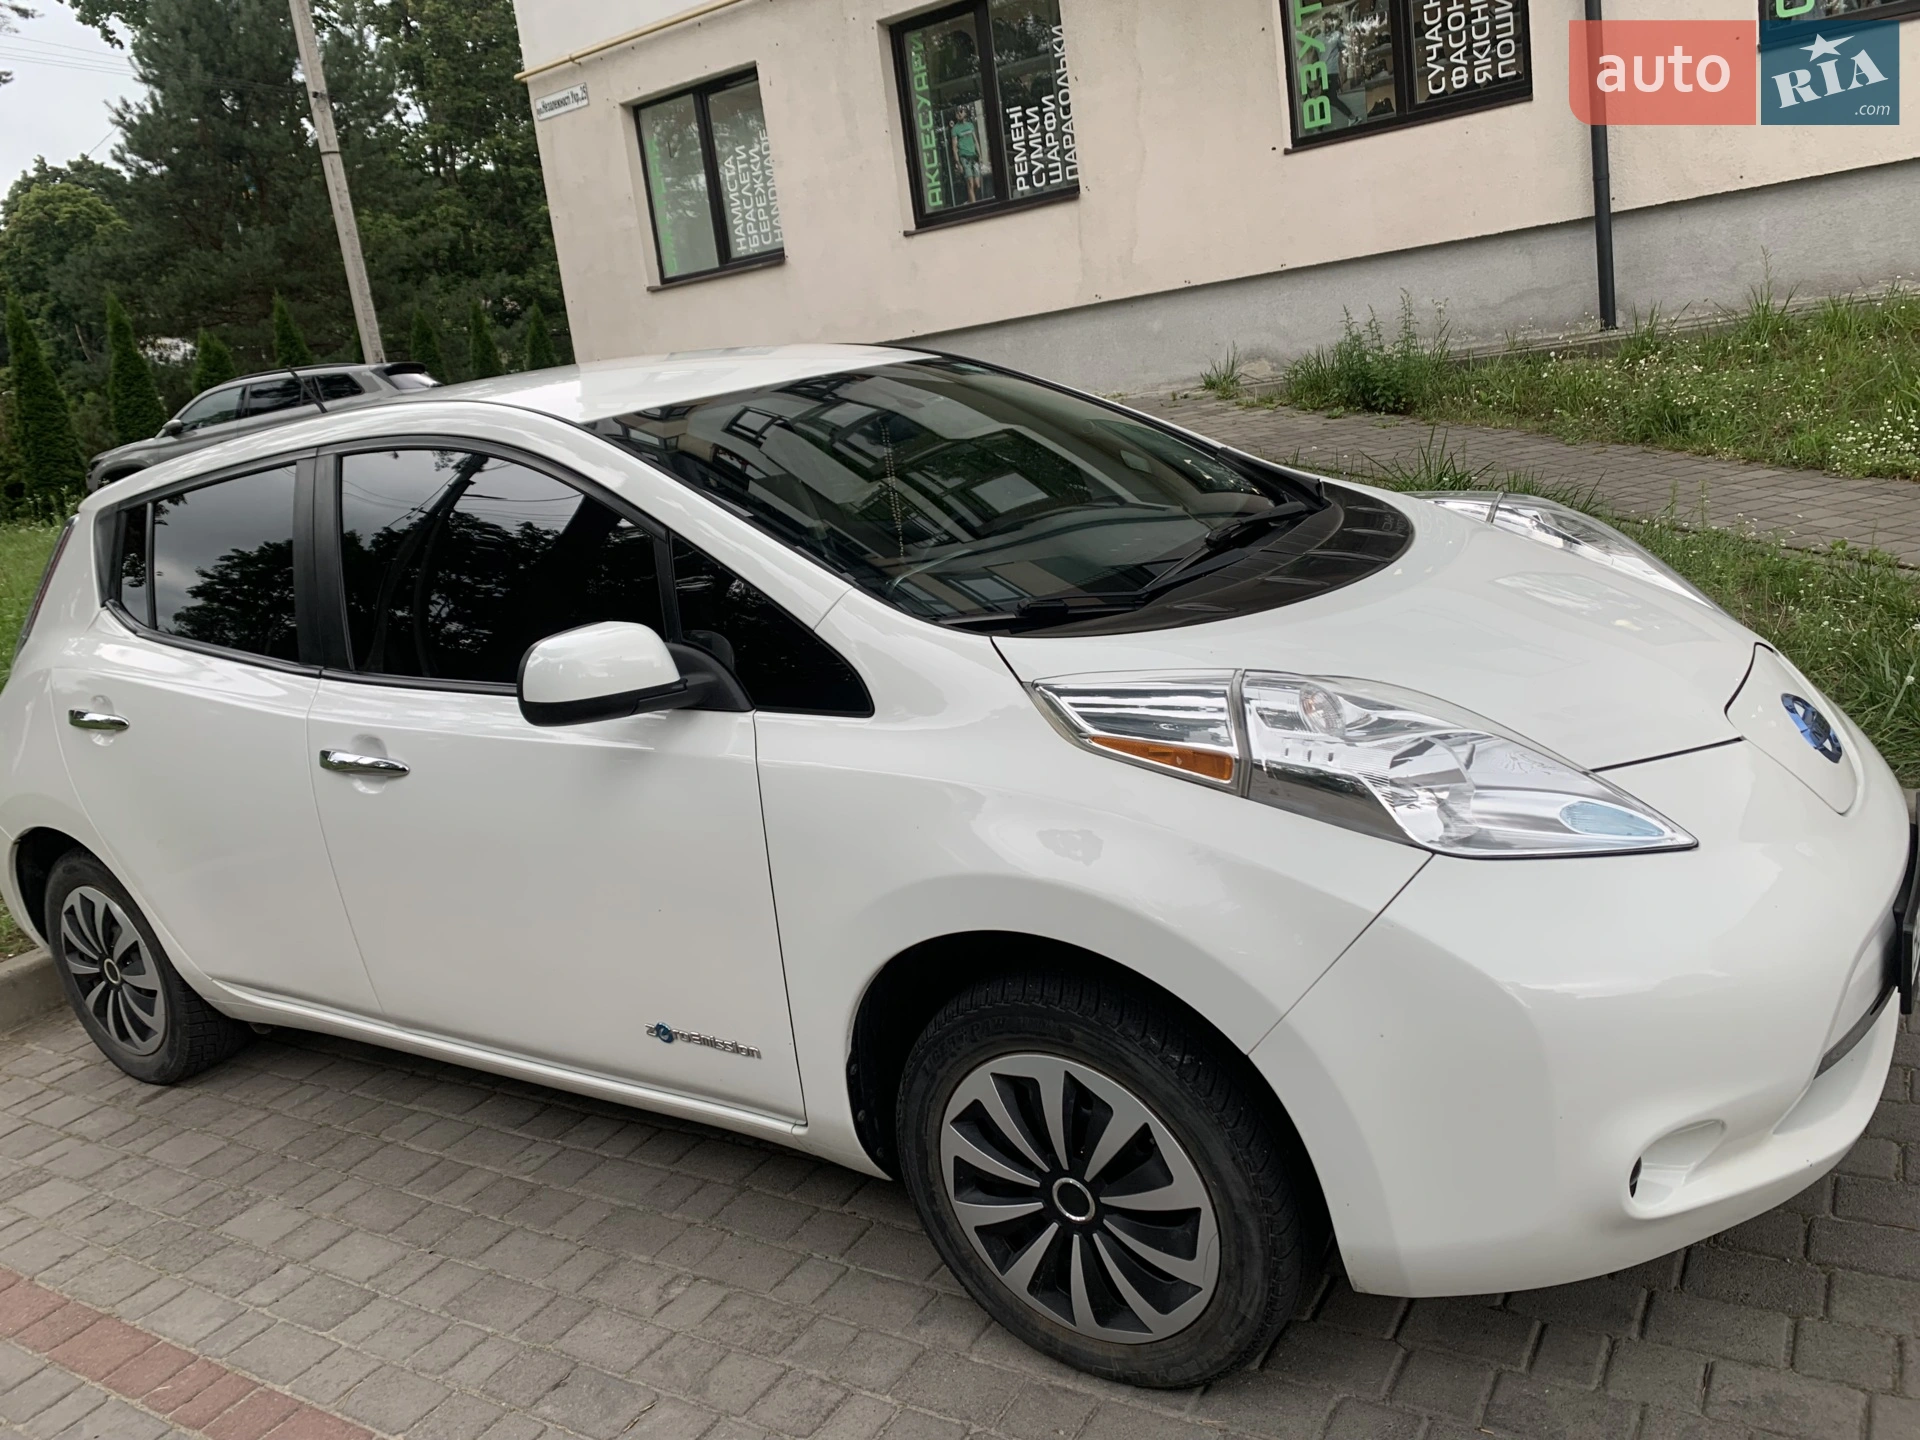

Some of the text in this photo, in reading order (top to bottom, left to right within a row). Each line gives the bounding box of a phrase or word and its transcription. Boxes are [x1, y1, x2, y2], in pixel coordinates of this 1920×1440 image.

[1471, 0, 1493, 84] ЯКІСН
[908, 32, 943, 207] АКСЕСУАРИ
[1006, 105, 1030, 191] РЕМЕНІ
[1026, 106, 1046, 188] СУМКИ
[1041, 94, 1063, 184] ШАРФИ
[1051, 25, 1079, 180] ПАРАСОЛЬКИ
[723, 155, 747, 251] НАМИСТА
[735, 145, 760, 248] БРАСЛЕТИ
[749, 147, 772, 246] СЕРЕЖКИ
